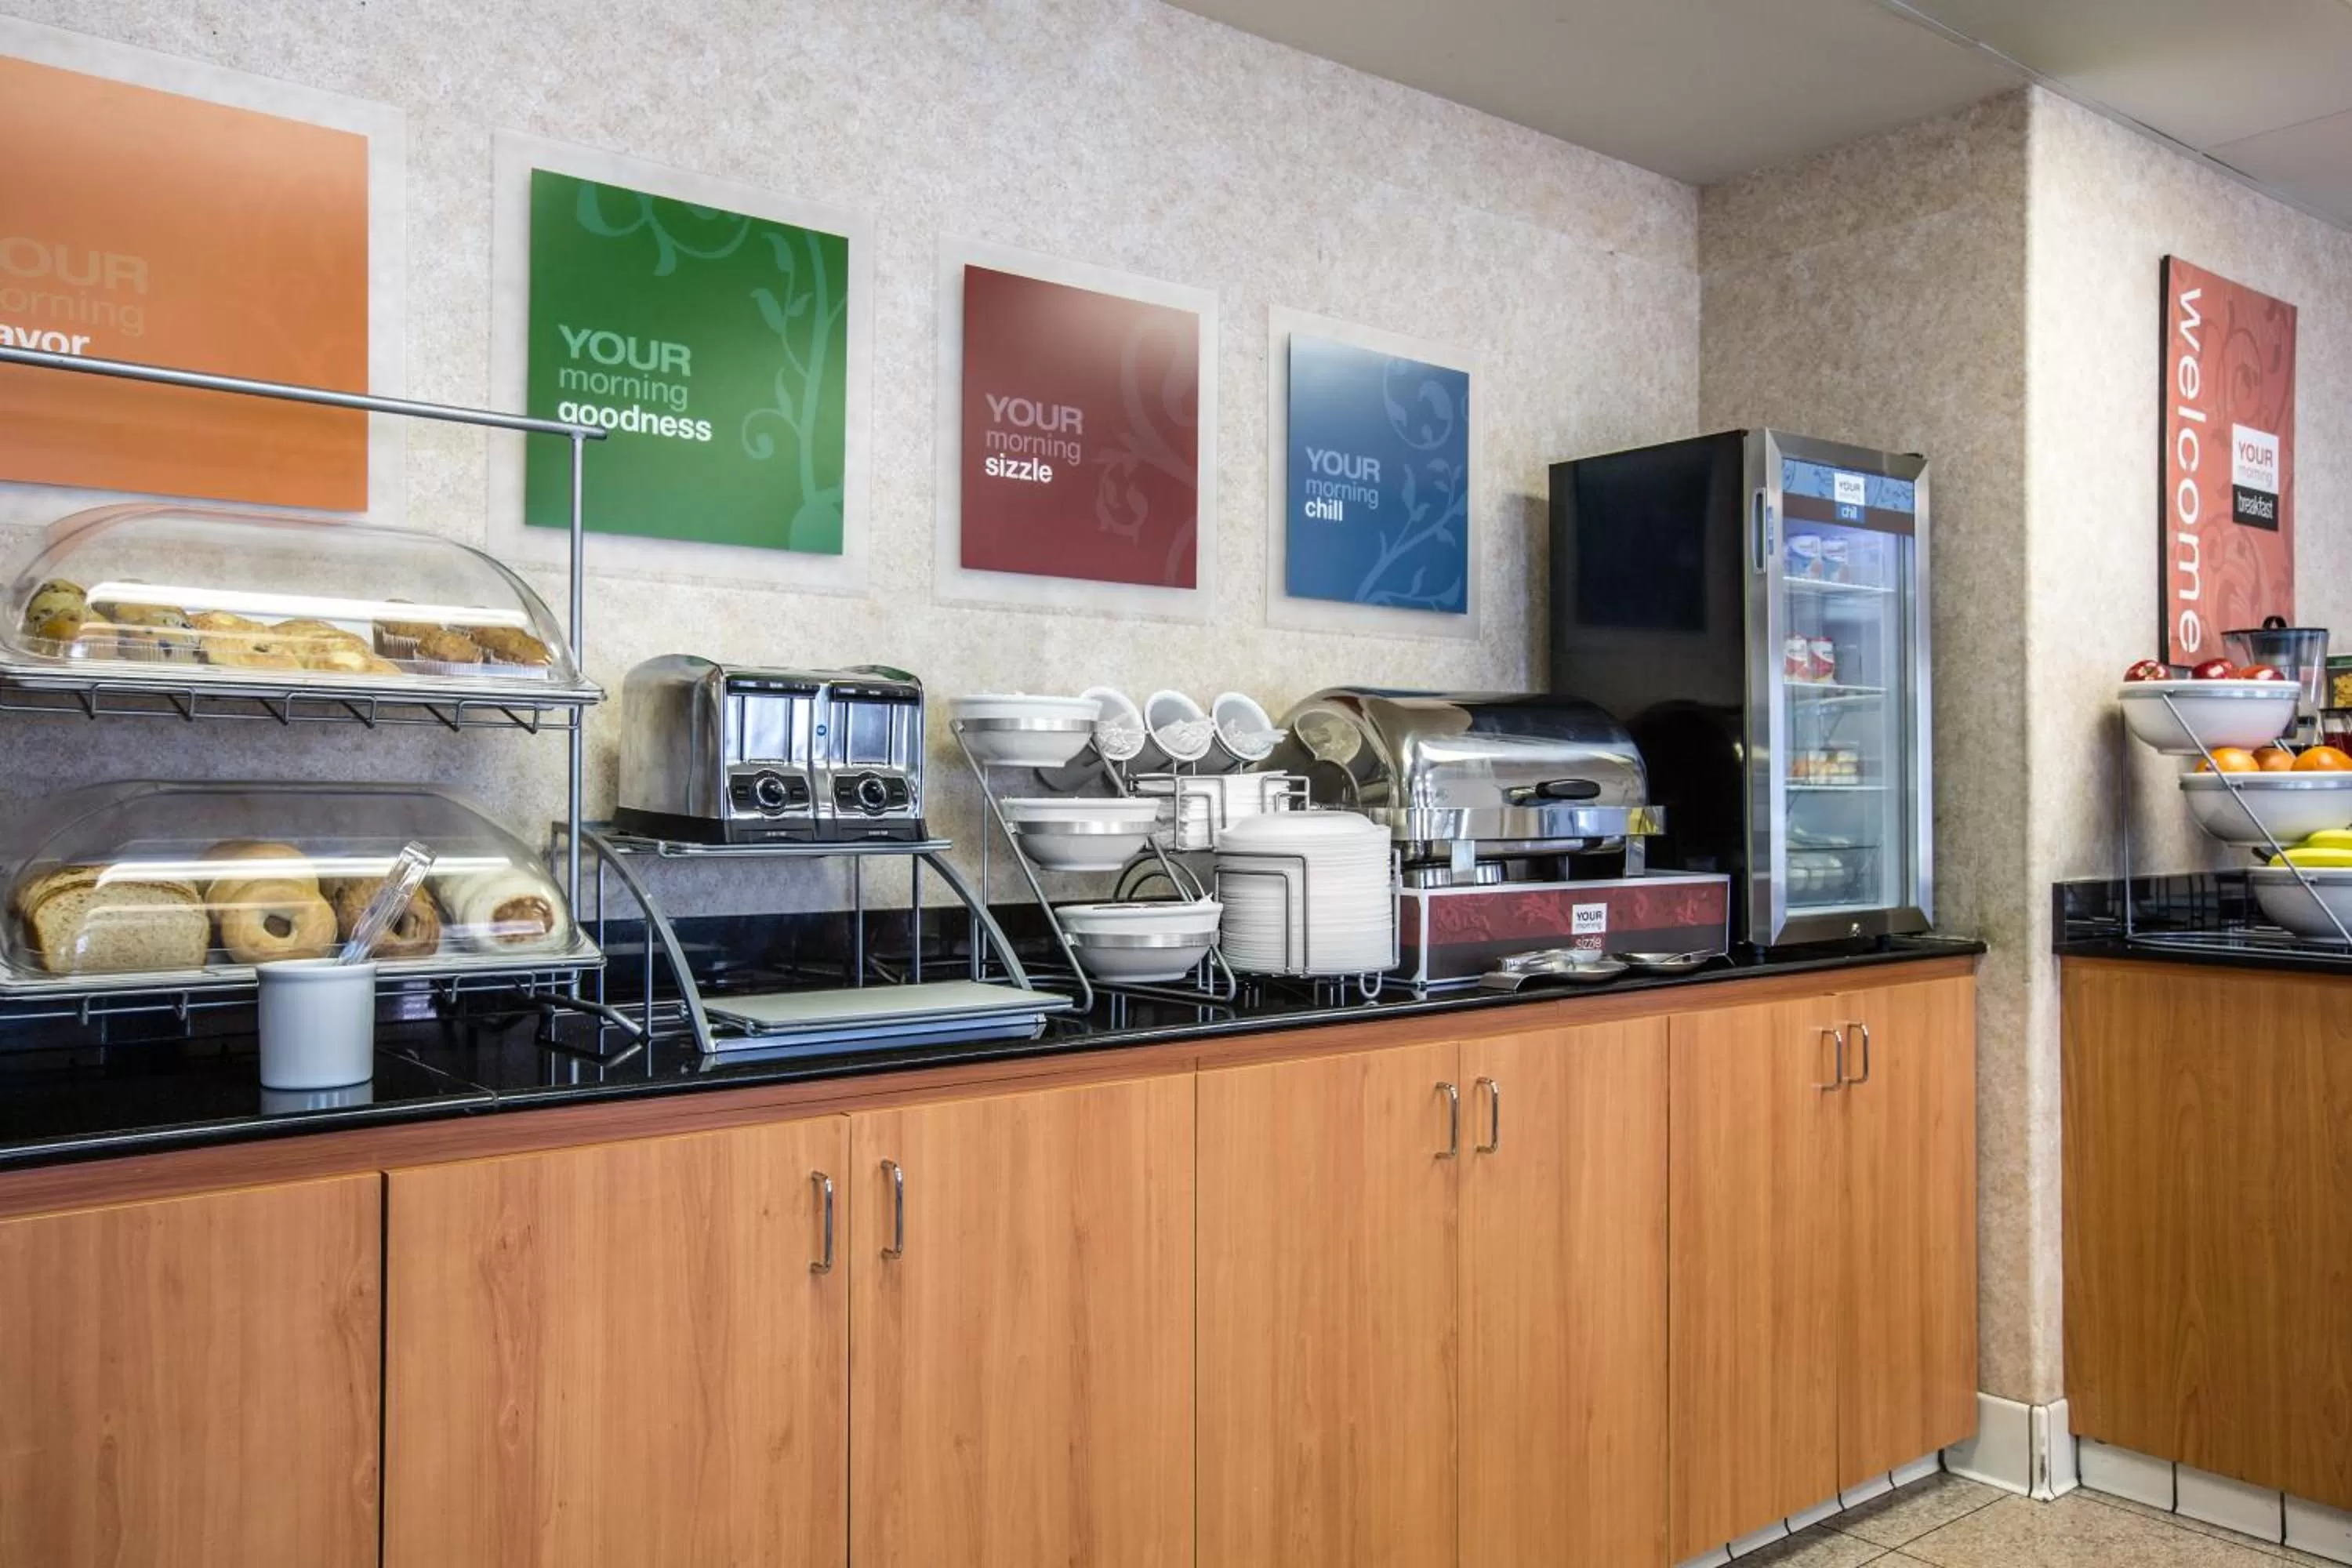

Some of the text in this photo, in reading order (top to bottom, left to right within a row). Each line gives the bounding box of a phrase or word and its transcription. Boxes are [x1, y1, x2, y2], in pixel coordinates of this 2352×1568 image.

[558, 323, 691, 377] YOUR
[559, 366, 688, 412] morning
[557, 401, 712, 441] goodness
[985, 393, 1083, 435] YOUR
[985, 429, 1081, 466] morning
[1305, 445, 1380, 483] YOUR
[2238, 441, 2273, 467] YOUR
[985, 452, 1053, 484] sizzle
[2177, 288, 2206, 653] welcome
[1305, 478, 1379, 510] morning
[1305, 496, 1343, 521] chill
[2237, 491, 2274, 520] breakfast
[1577, 910, 1603, 921] YOUR
[1575, 935, 1602, 949] sizzle
